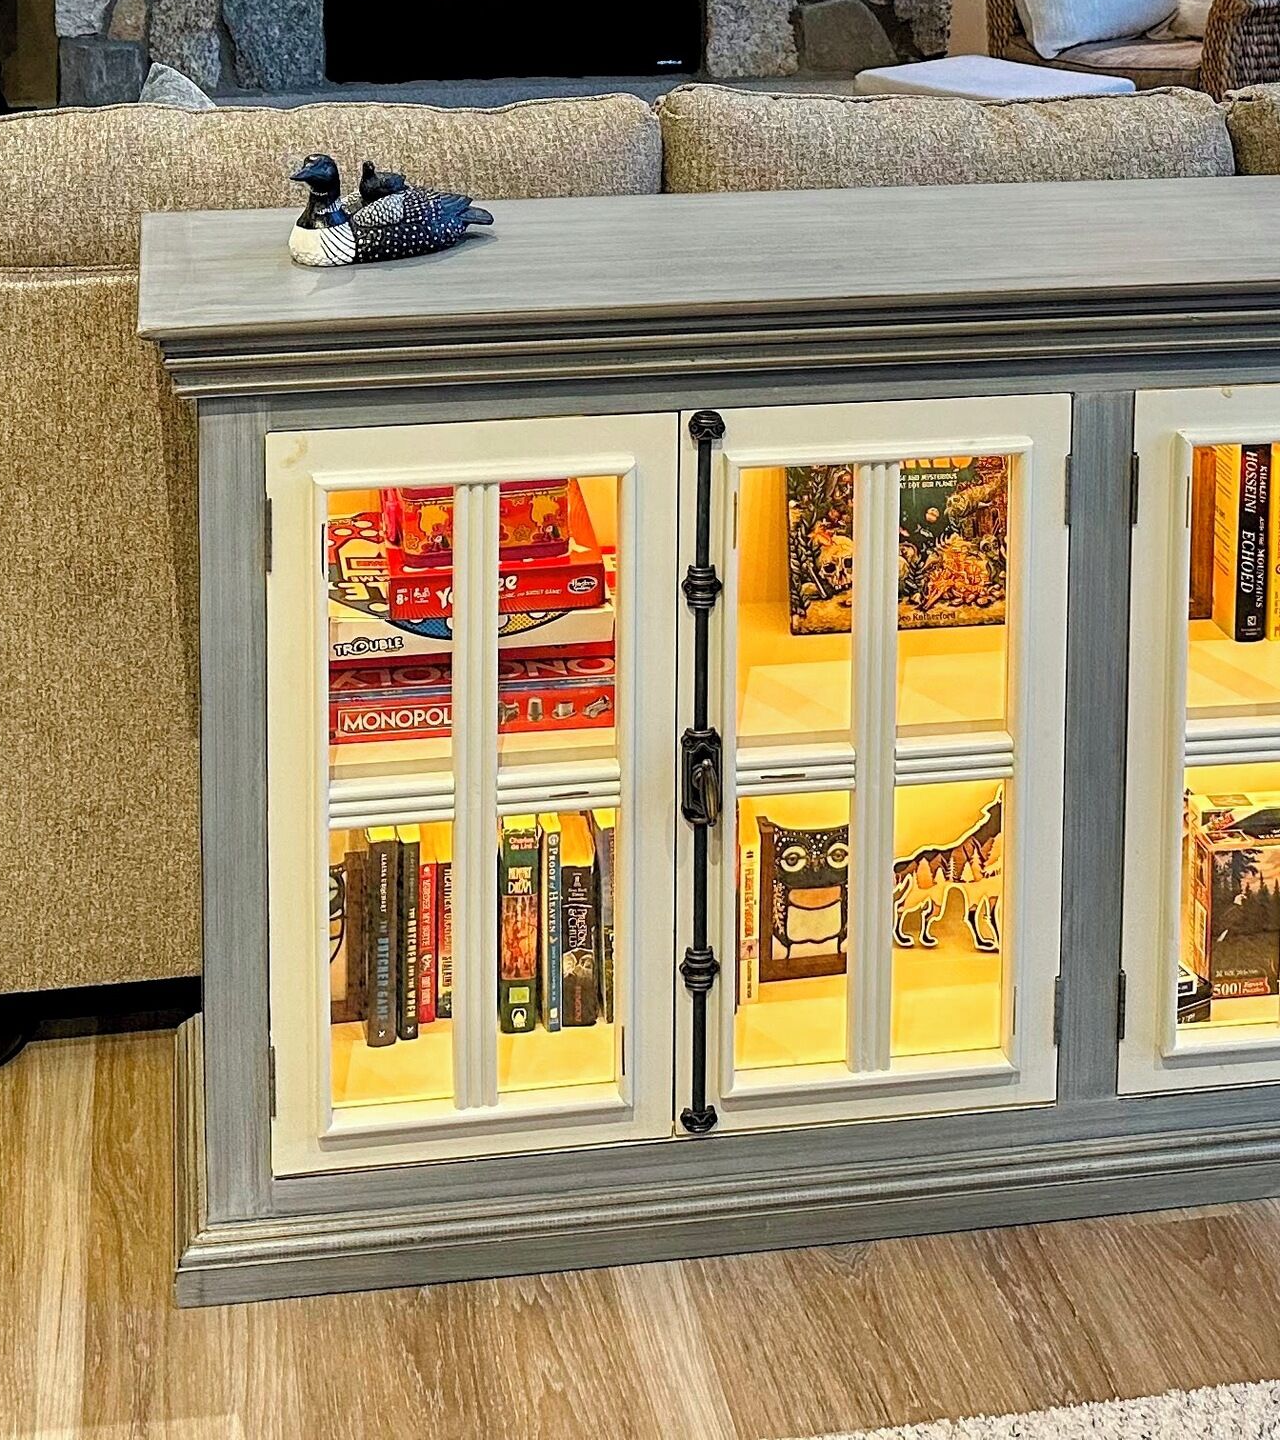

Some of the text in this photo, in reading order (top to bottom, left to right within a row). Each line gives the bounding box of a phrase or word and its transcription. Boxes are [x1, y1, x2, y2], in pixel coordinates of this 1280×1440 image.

[935, 480, 958, 488] PLANET
[1244, 451, 1268, 514] KHALED HOSSEINI
[1240, 529, 1256, 593] ECHOED
[1255, 548, 1266, 609] MOUNTAINS
[913, 612, 956, 621] Rutherford
[334, 637, 404, 656] TROUBLE
[343, 707, 452, 731] MONOPOL
[548, 847, 558, 881] PROOF
[548, 891, 559, 933] HEAVEN
[576, 908, 588, 948] PRESTON
[406, 920, 417, 964] BUTCHER
[567, 917, 578, 948] CHILD
[376, 938, 390, 987] BUTCHER
[406, 990, 417, 1018] WREN
[1213, 982, 1238, 996] 500
[376, 991, 389, 1021] GAME
